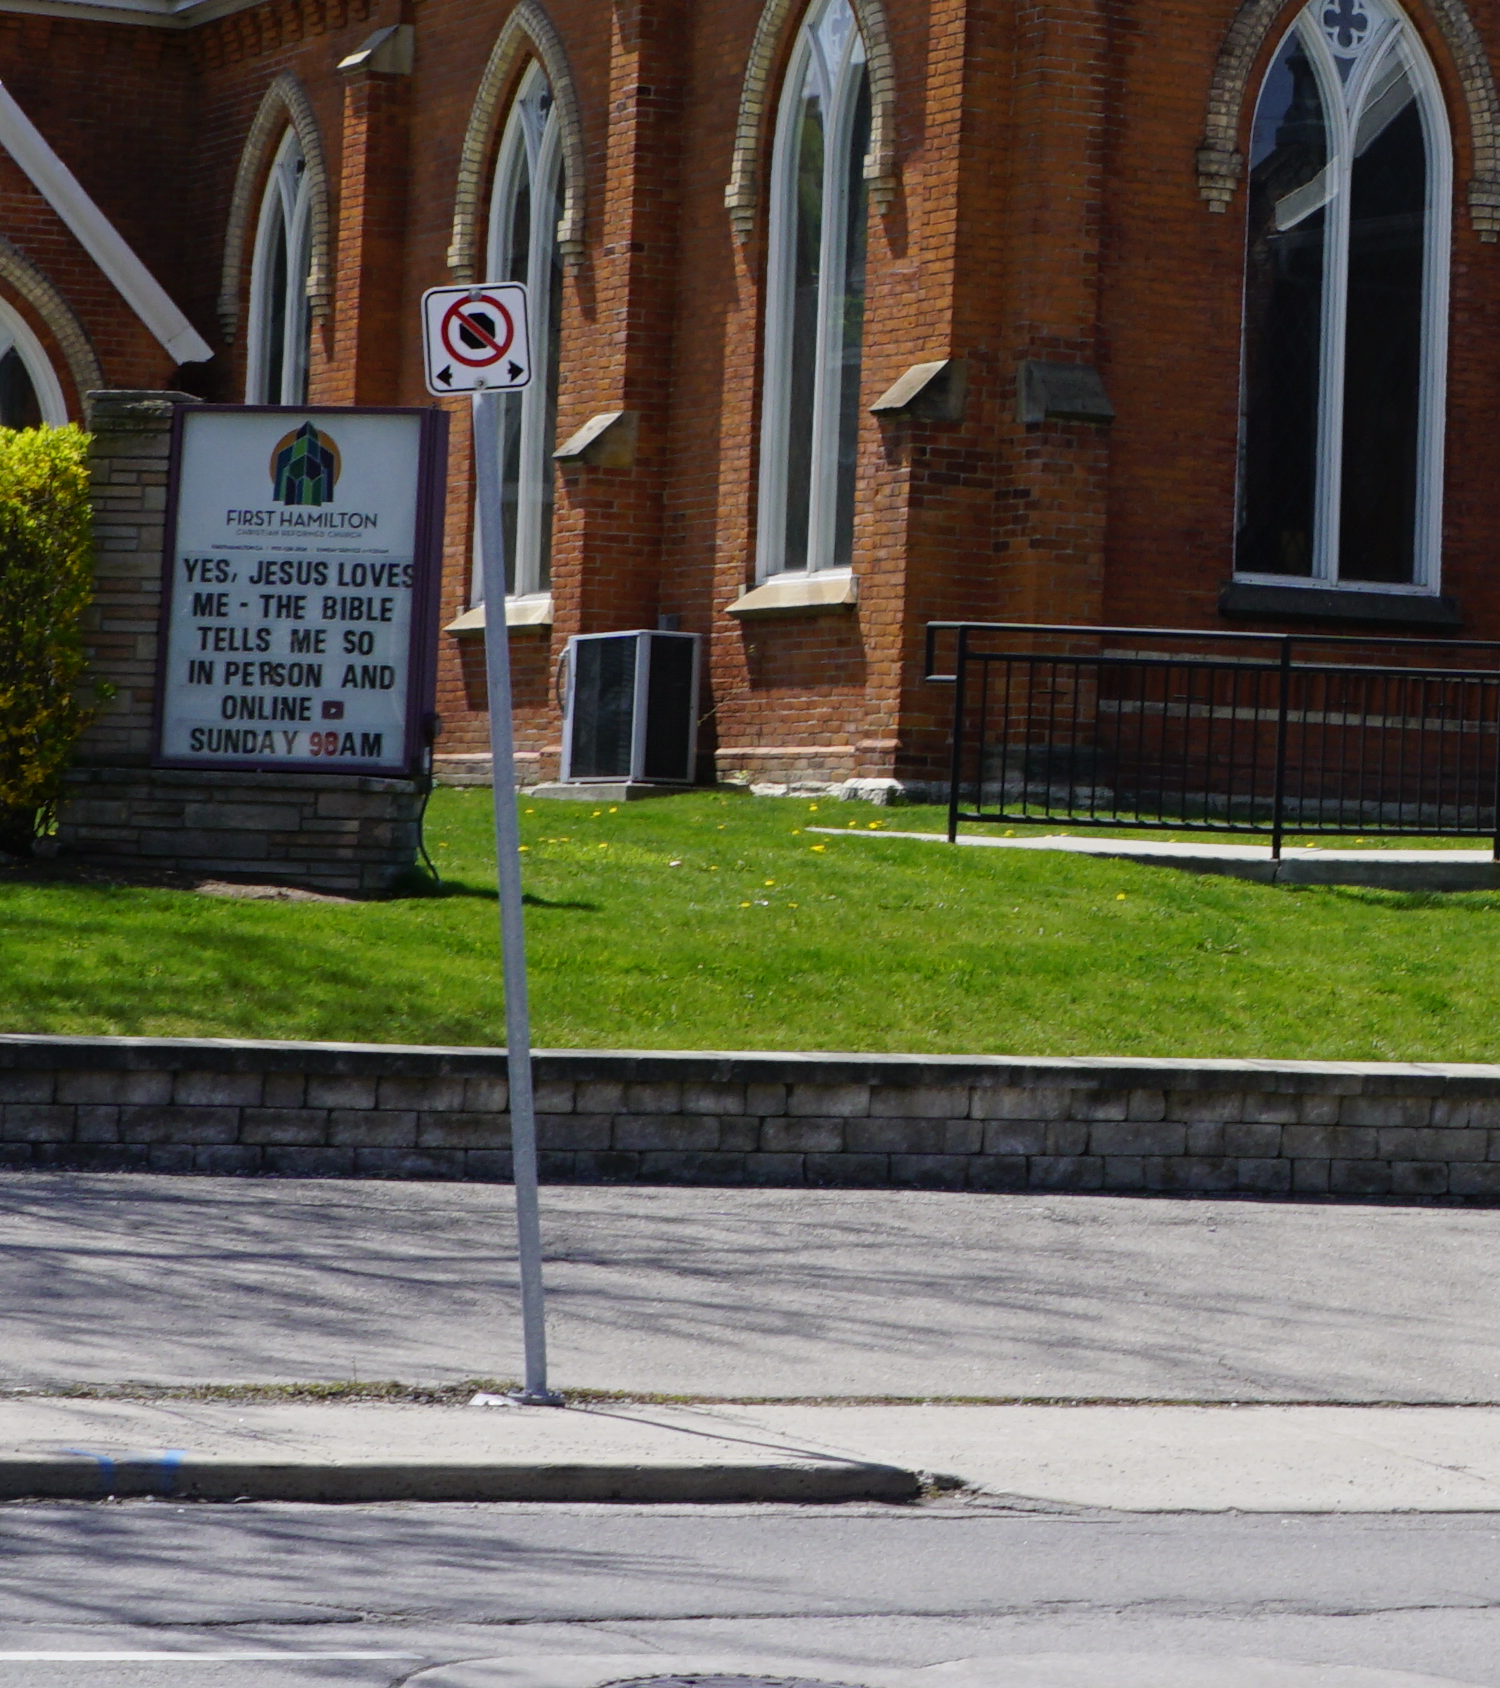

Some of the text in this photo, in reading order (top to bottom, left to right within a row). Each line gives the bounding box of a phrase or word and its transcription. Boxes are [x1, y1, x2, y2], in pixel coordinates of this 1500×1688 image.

[226, 509, 379, 529] FIRST HAMILTON
[235, 528, 362, 539] CHRISTIAN REFORMED CHURCH
[183, 558, 414, 589] YES, JESUS LOVES
[192, 592, 230, 618] ME
[259, 594, 308, 620] THE
[321, 596, 394, 622] BIBLE
[197, 626, 375, 655] TELLS ME SO
[188, 659, 396, 690] IN PERSON AND
[221, 694, 312, 721] ONLINE
[189, 727, 299, 754] SUNDAY
